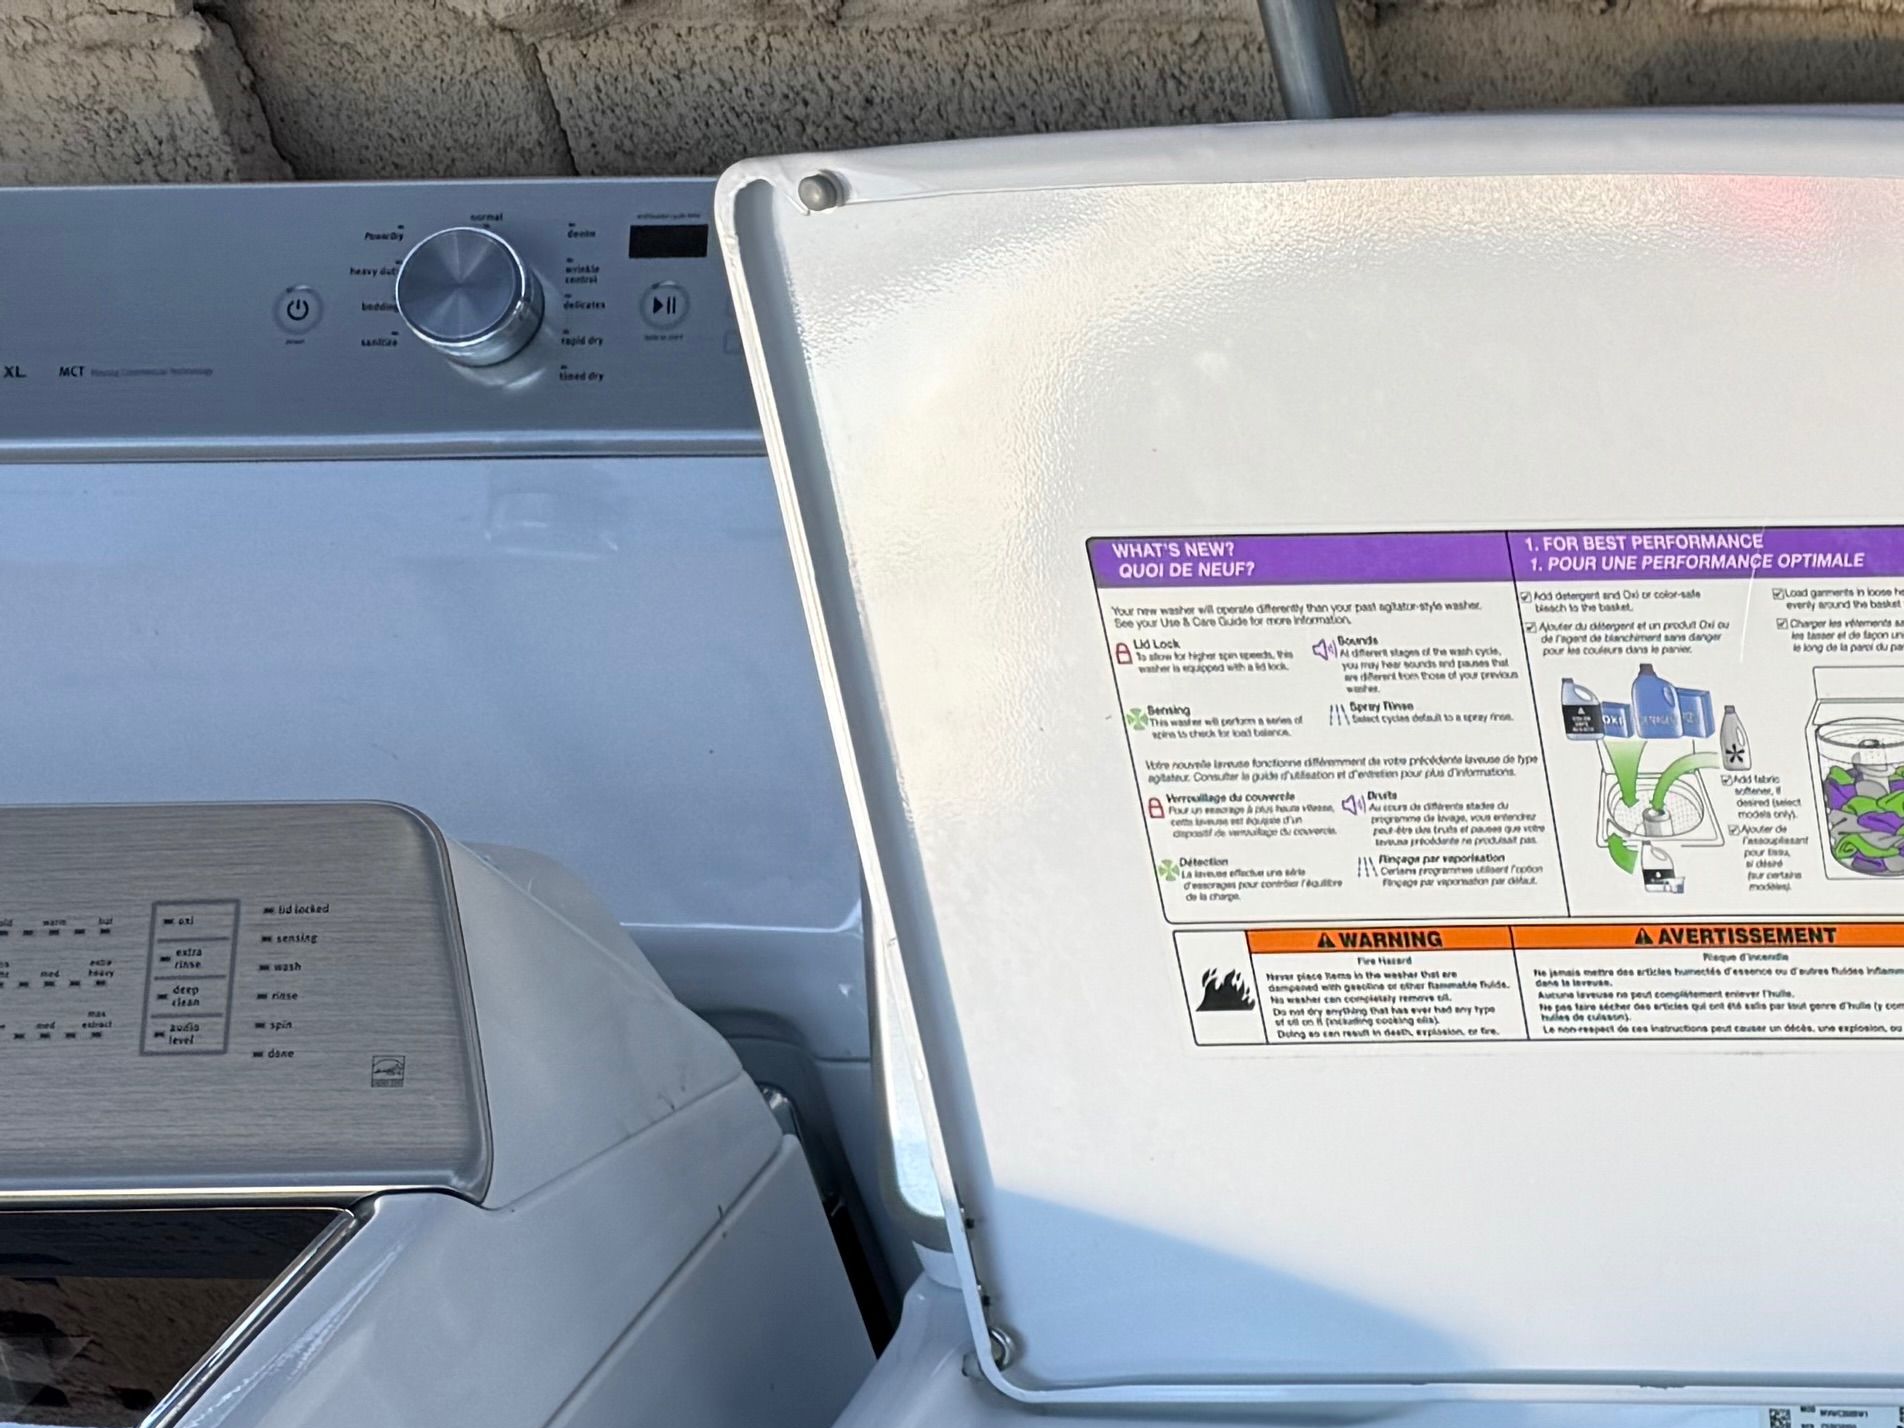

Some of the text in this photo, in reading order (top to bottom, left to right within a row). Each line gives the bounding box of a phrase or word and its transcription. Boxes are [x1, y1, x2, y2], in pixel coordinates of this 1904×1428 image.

[470, 213, 503, 221] normal
[587, 336, 603, 347] dry
[4, 366, 27, 378] XL
[59, 366, 86, 377] MCT
[588, 372, 603, 383] dry
[1526, 534, 1763, 552] 1. FOR BEST PERFORMANCE
[1112, 541, 1234, 559] WHAT'S NEW?
[1531, 553, 1864, 571] 1. POUR UNE PERFORMANCE OPTIMALE
[1119, 561, 1255, 579] QUOI DE NEUF?
[1153, 639, 1180, 650] Lock
[279, 904, 329, 914] lid locked
[277, 933, 318, 944] sensing
[1339, 931, 1443, 949] WARNING
[1658, 928, 1837, 945] AVERTISSEMENT
[176, 948, 202, 956] extra
[174, 961, 201, 969] rinse
[274, 962, 301, 971] wash
[173, 986, 199, 995] deep
[272, 992, 298, 1000] rinse
[172, 998, 200, 1007] clean
[170, 1022, 199, 1032] audio
[270, 1020, 292, 1031] spin
[169, 1036, 194, 1045] level
[268, 1049, 294, 1058] done
